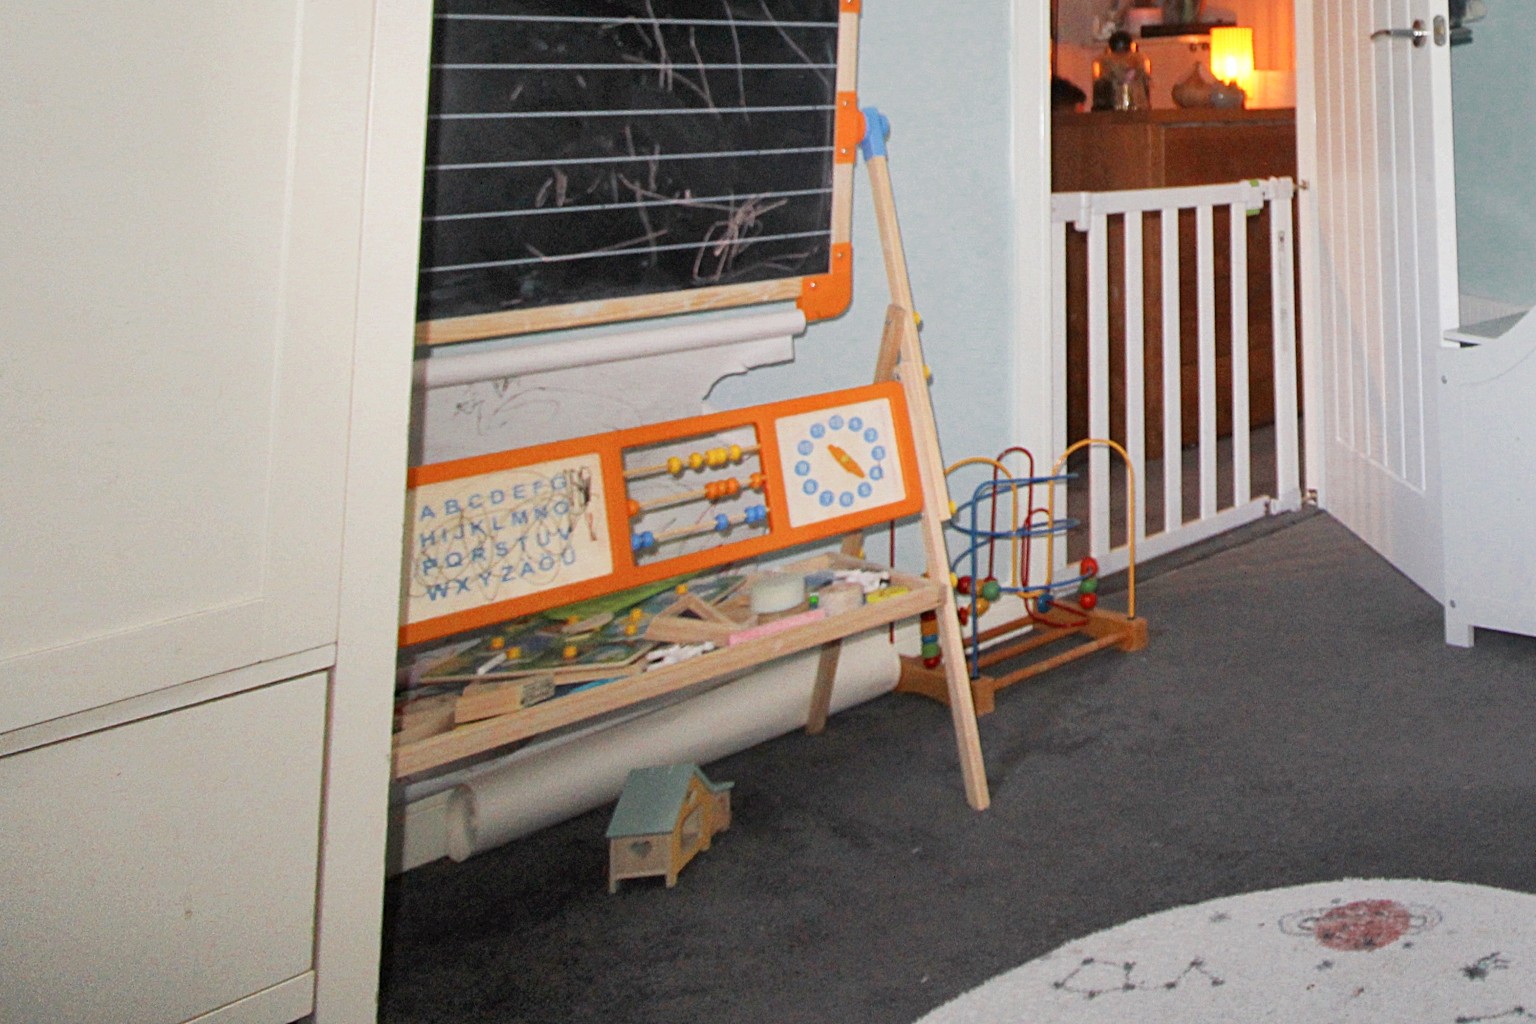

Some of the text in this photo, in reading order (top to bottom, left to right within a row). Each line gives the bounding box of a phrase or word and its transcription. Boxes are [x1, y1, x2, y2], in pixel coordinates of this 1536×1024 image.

[420, 505, 436, 521] A
[444, 499, 460, 515] B
[468, 494, 482, 509] C
[490, 489, 504, 504] D
[513, 484, 526, 499] E
[533, 481, 544, 494] F
[420, 531, 436, 547] H
[454, 524, 464, 539] J
[471, 521, 485, 535] K
[492, 517, 504, 530] L
[511, 509, 529, 525] M
[533, 505, 548, 520] N
[553, 499, 570, 515] O
[423, 558, 437, 576] P
[495, 541, 508, 556] S
[517, 535, 529, 552] T
[536, 530, 550, 547] U
[427, 582, 449, 601] W
[456, 577, 471, 594] X
[478, 571, 492, 587] Y
[501, 565, 515, 582] Z
